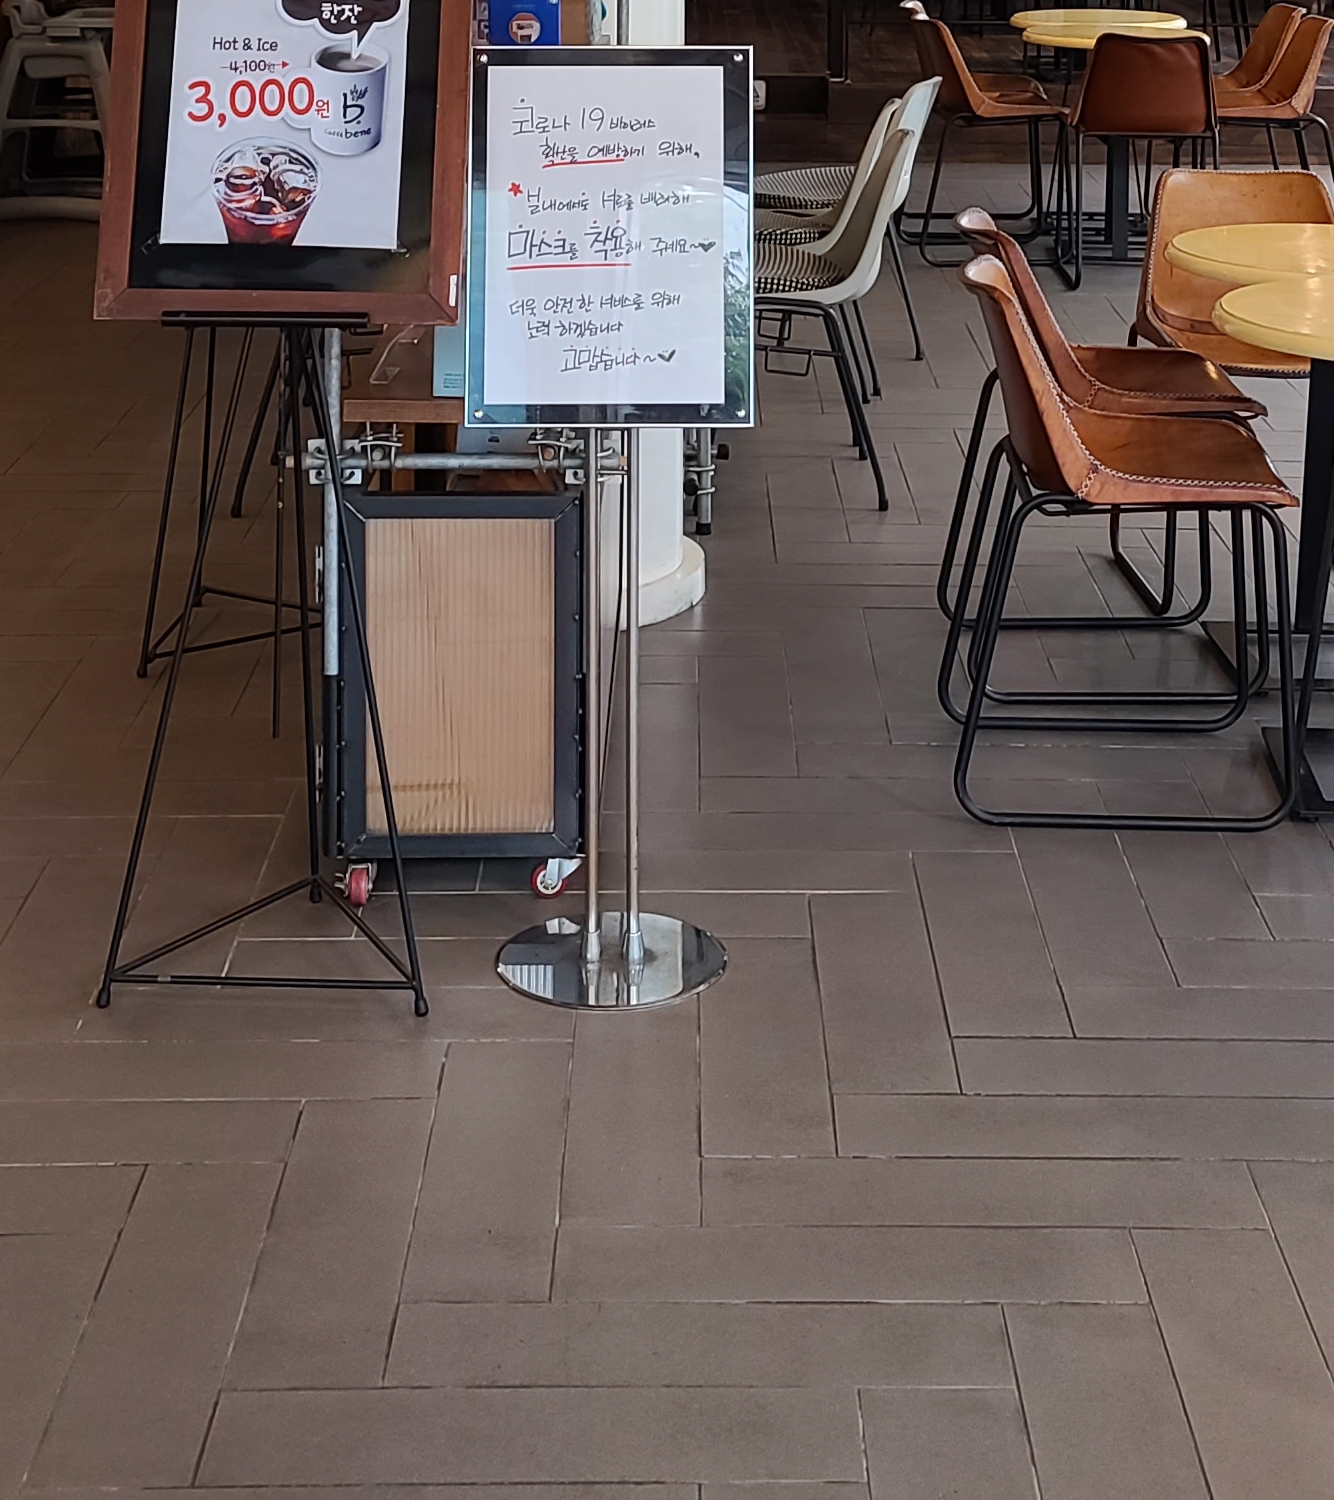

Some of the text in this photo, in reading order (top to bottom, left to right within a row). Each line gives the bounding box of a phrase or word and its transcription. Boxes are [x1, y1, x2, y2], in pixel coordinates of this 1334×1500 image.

[320, 2, 363, 24] 한잔
[212, 37, 278, 51] Hot & Ice
[187, 77, 330, 128] 3,000원
[512, 105, 657, 135] 코로나 19 바이러스
[539, 137, 579, 164] 확산을
[586, 142, 646, 158] 예방하기
[527, 187, 690, 215] 실내에서도 서로를 배려해
[507, 228, 579, 260] 마스크를
[584, 224, 642, 261] 착용해
[509, 298, 537, 317] 더욱
[650, 290, 682, 309] 위해
